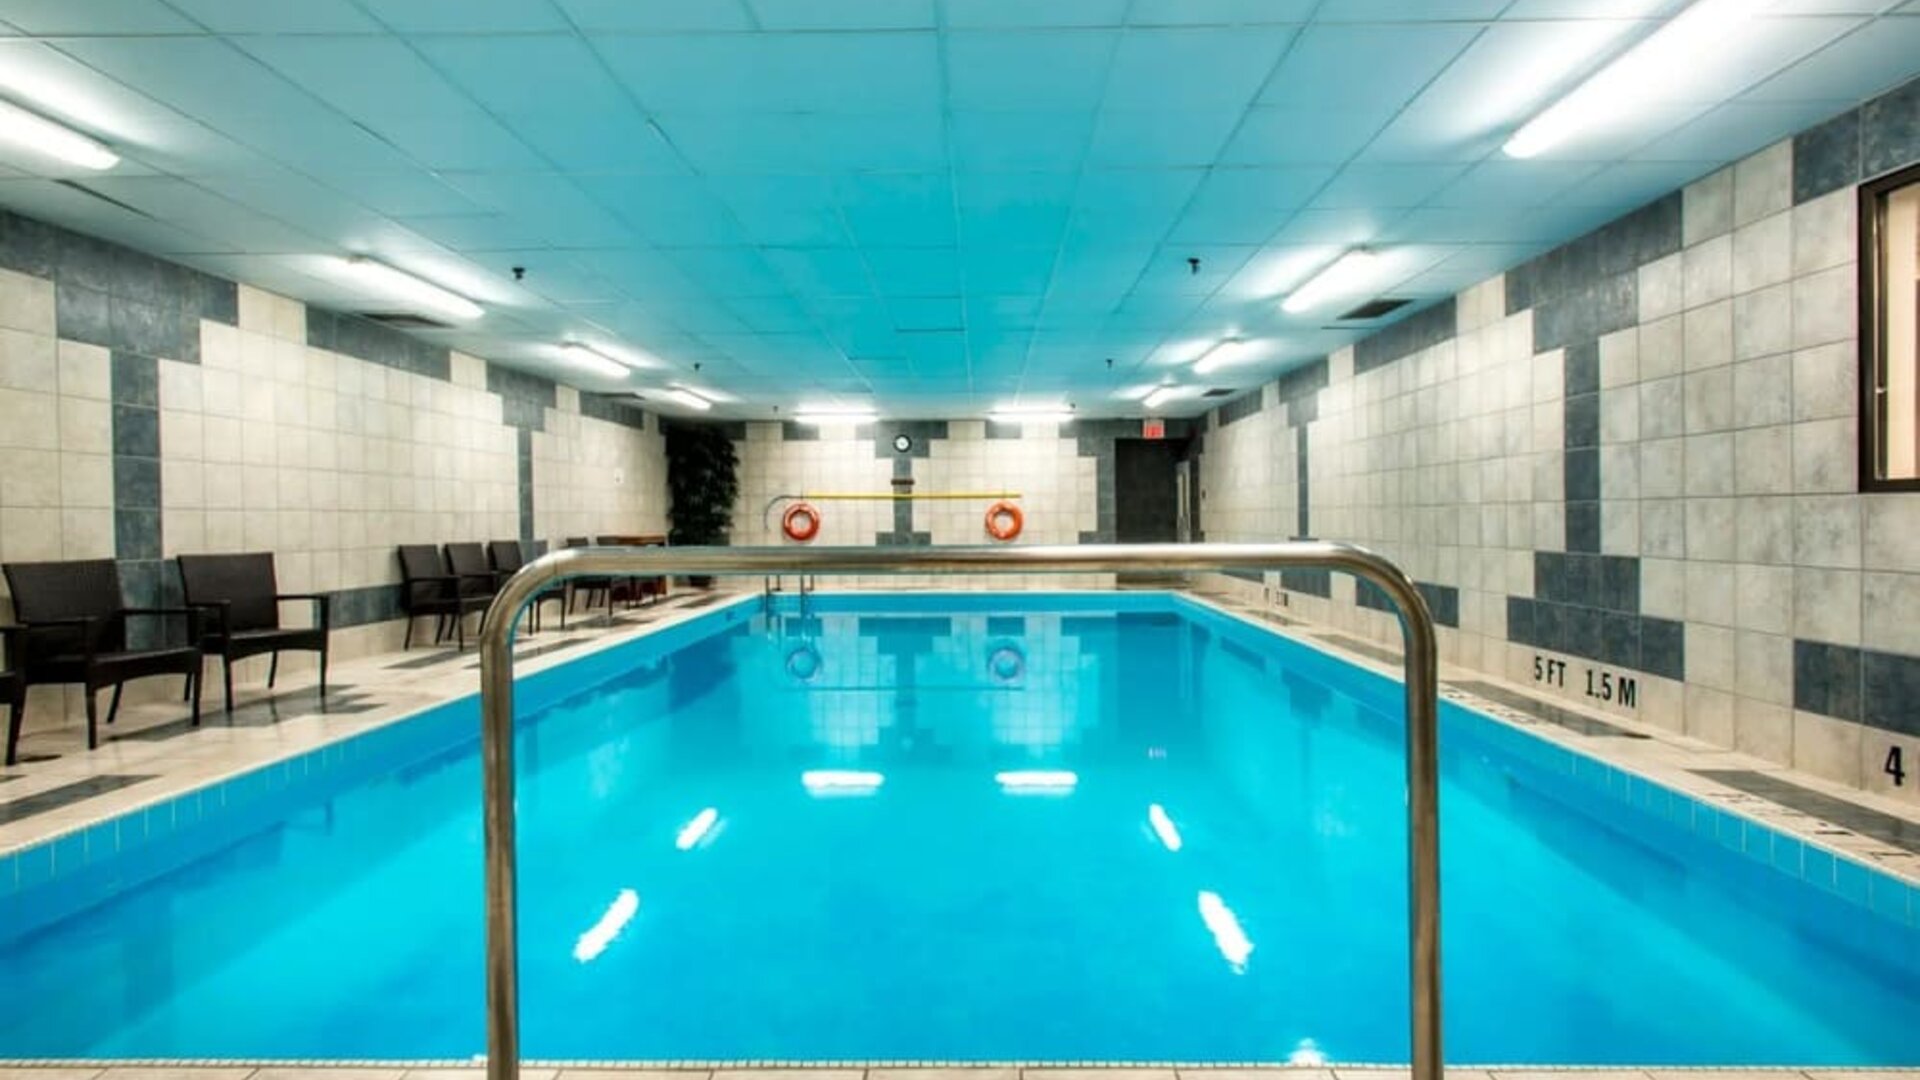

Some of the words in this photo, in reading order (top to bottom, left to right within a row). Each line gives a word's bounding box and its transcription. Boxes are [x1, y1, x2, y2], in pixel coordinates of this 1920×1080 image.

[1535, 656, 1543, 681] 5
[1547, 659, 1566, 688] FT
[1586, 669, 1612, 701] 1.5
[1618, 677, 1636, 708] M
[1884, 745, 1906, 786] 4
